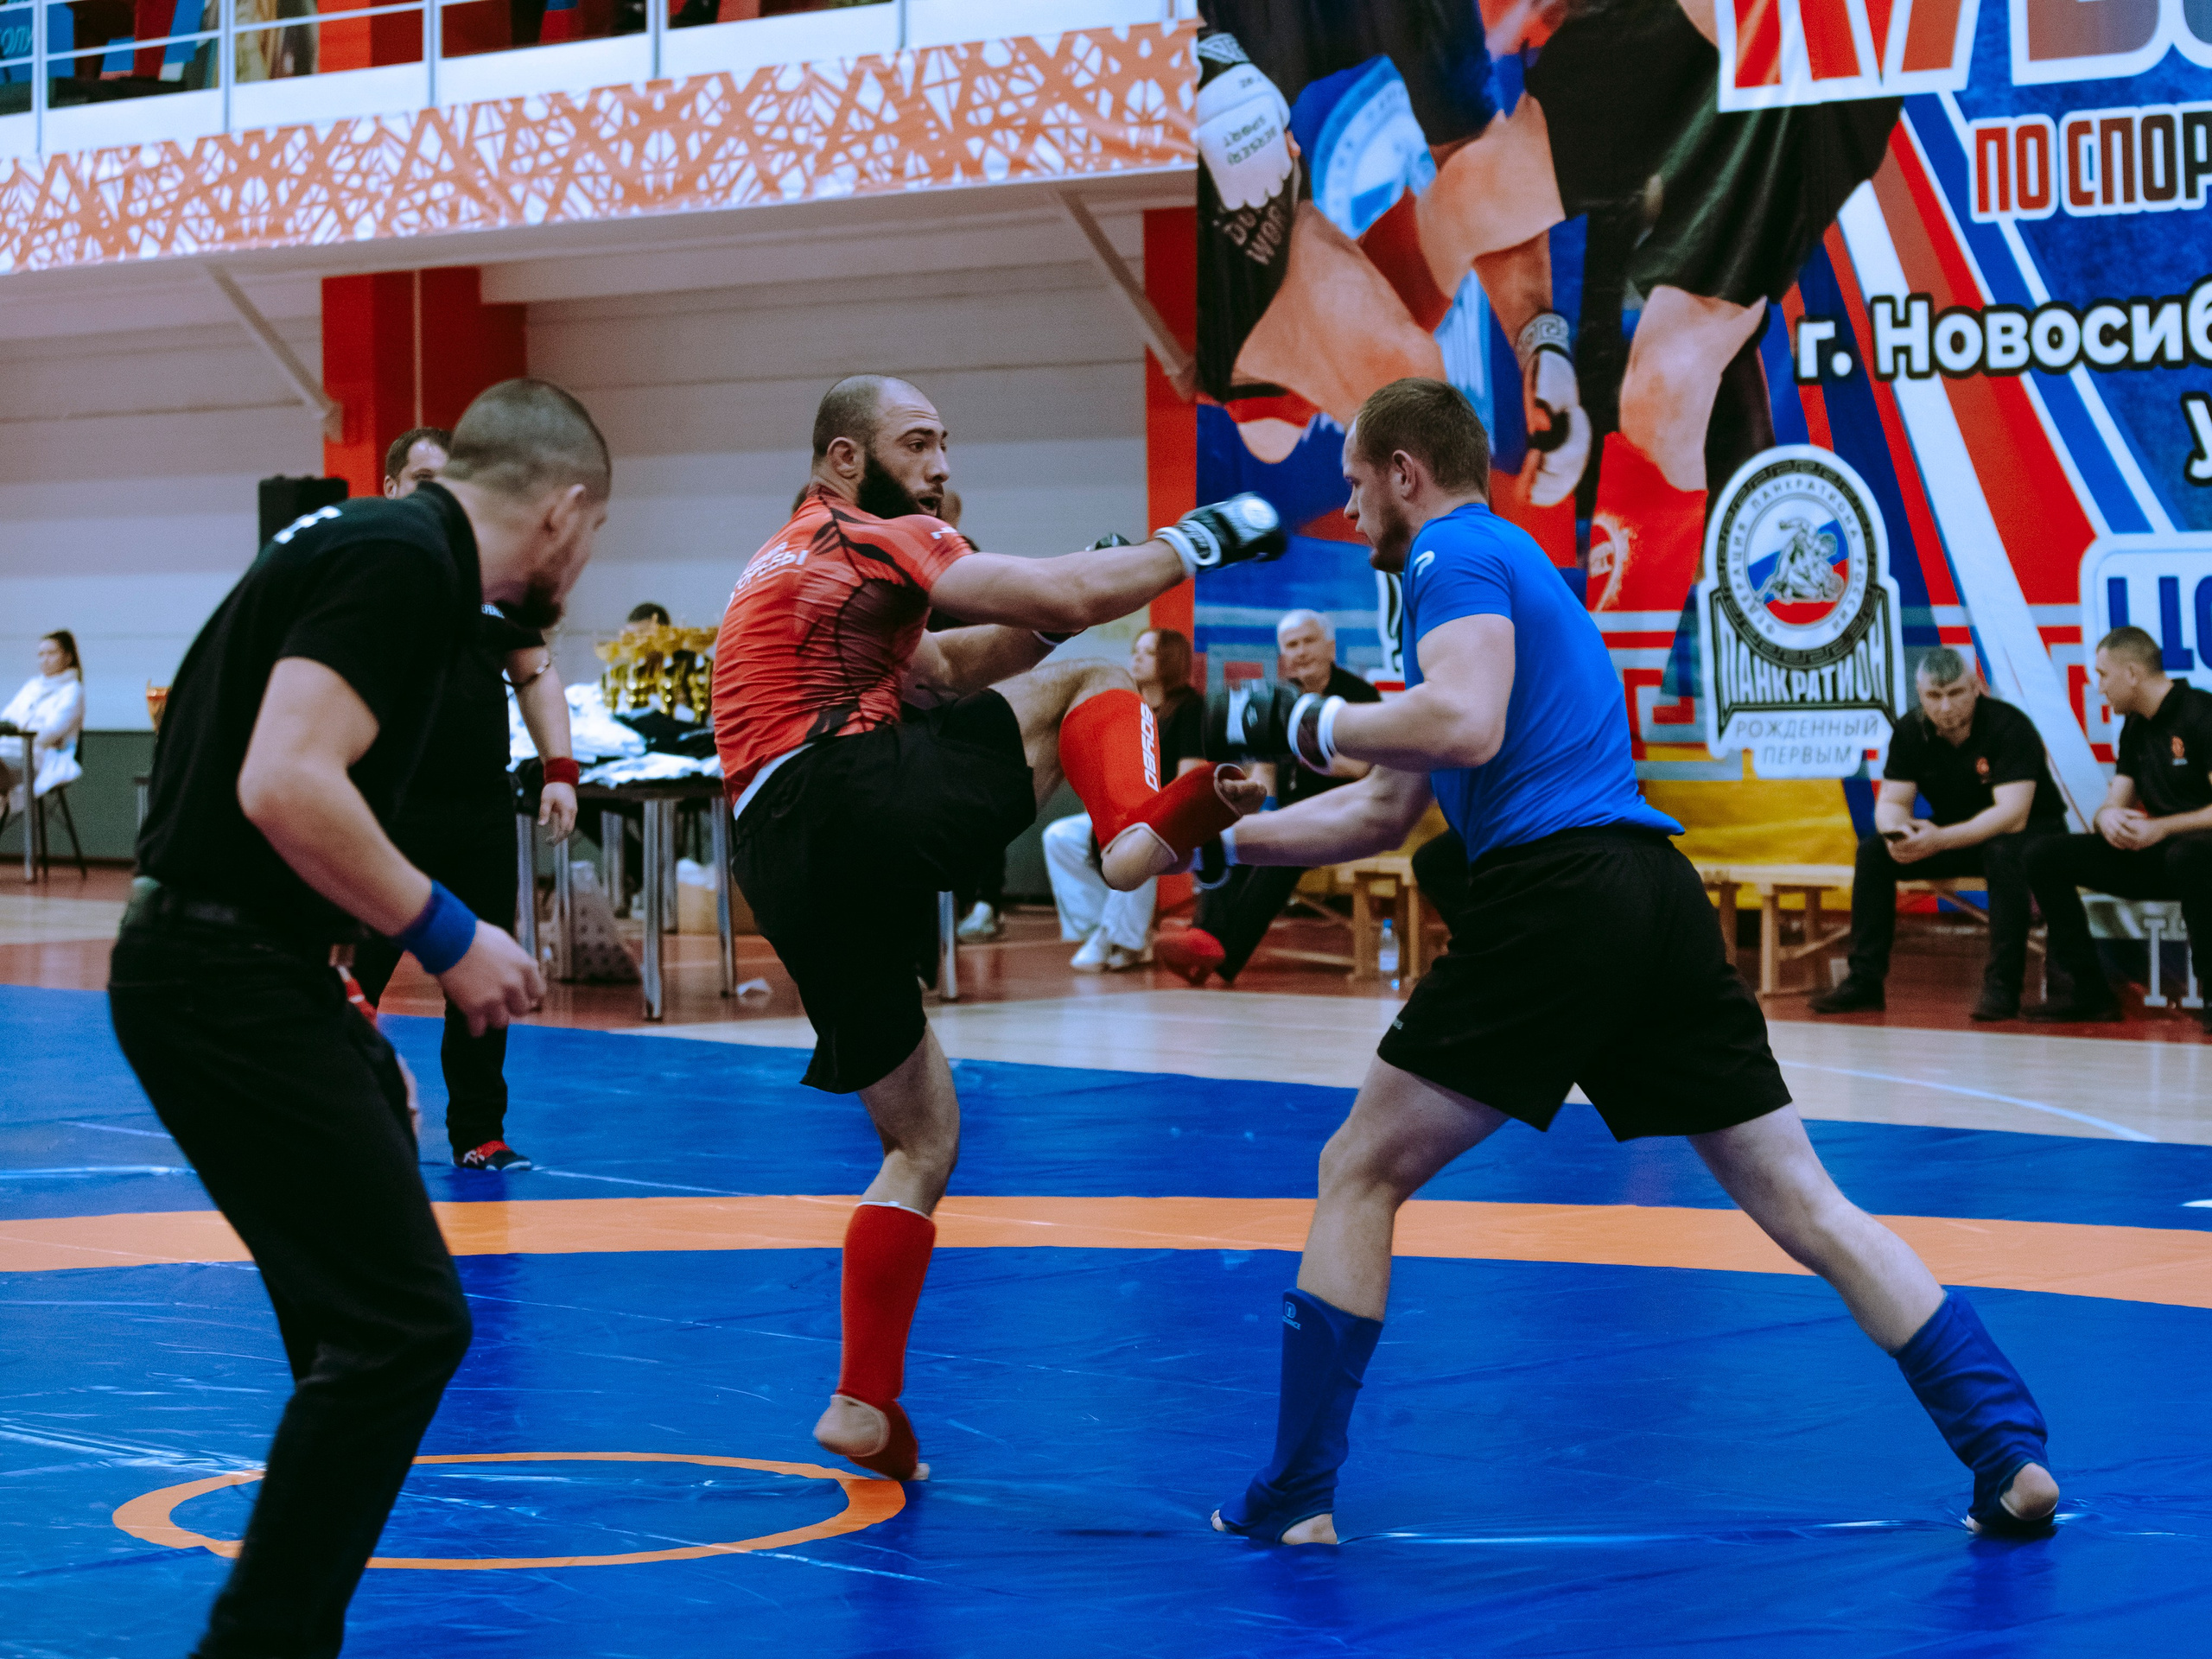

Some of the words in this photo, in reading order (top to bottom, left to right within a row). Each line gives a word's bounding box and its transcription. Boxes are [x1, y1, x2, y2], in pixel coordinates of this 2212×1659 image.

[1975, 124, 2050, 214] ПО
[2068, 111, 2212, 209] СПОР
[1718, 598, 1890, 710] ПАНКРАТИОН
[1140, 701, 1160, 793] BOYBO
[1736, 715, 1879, 740] РОЖДЕННЫЙ
[1763, 745, 1852, 766] ПЕРВЫМ
